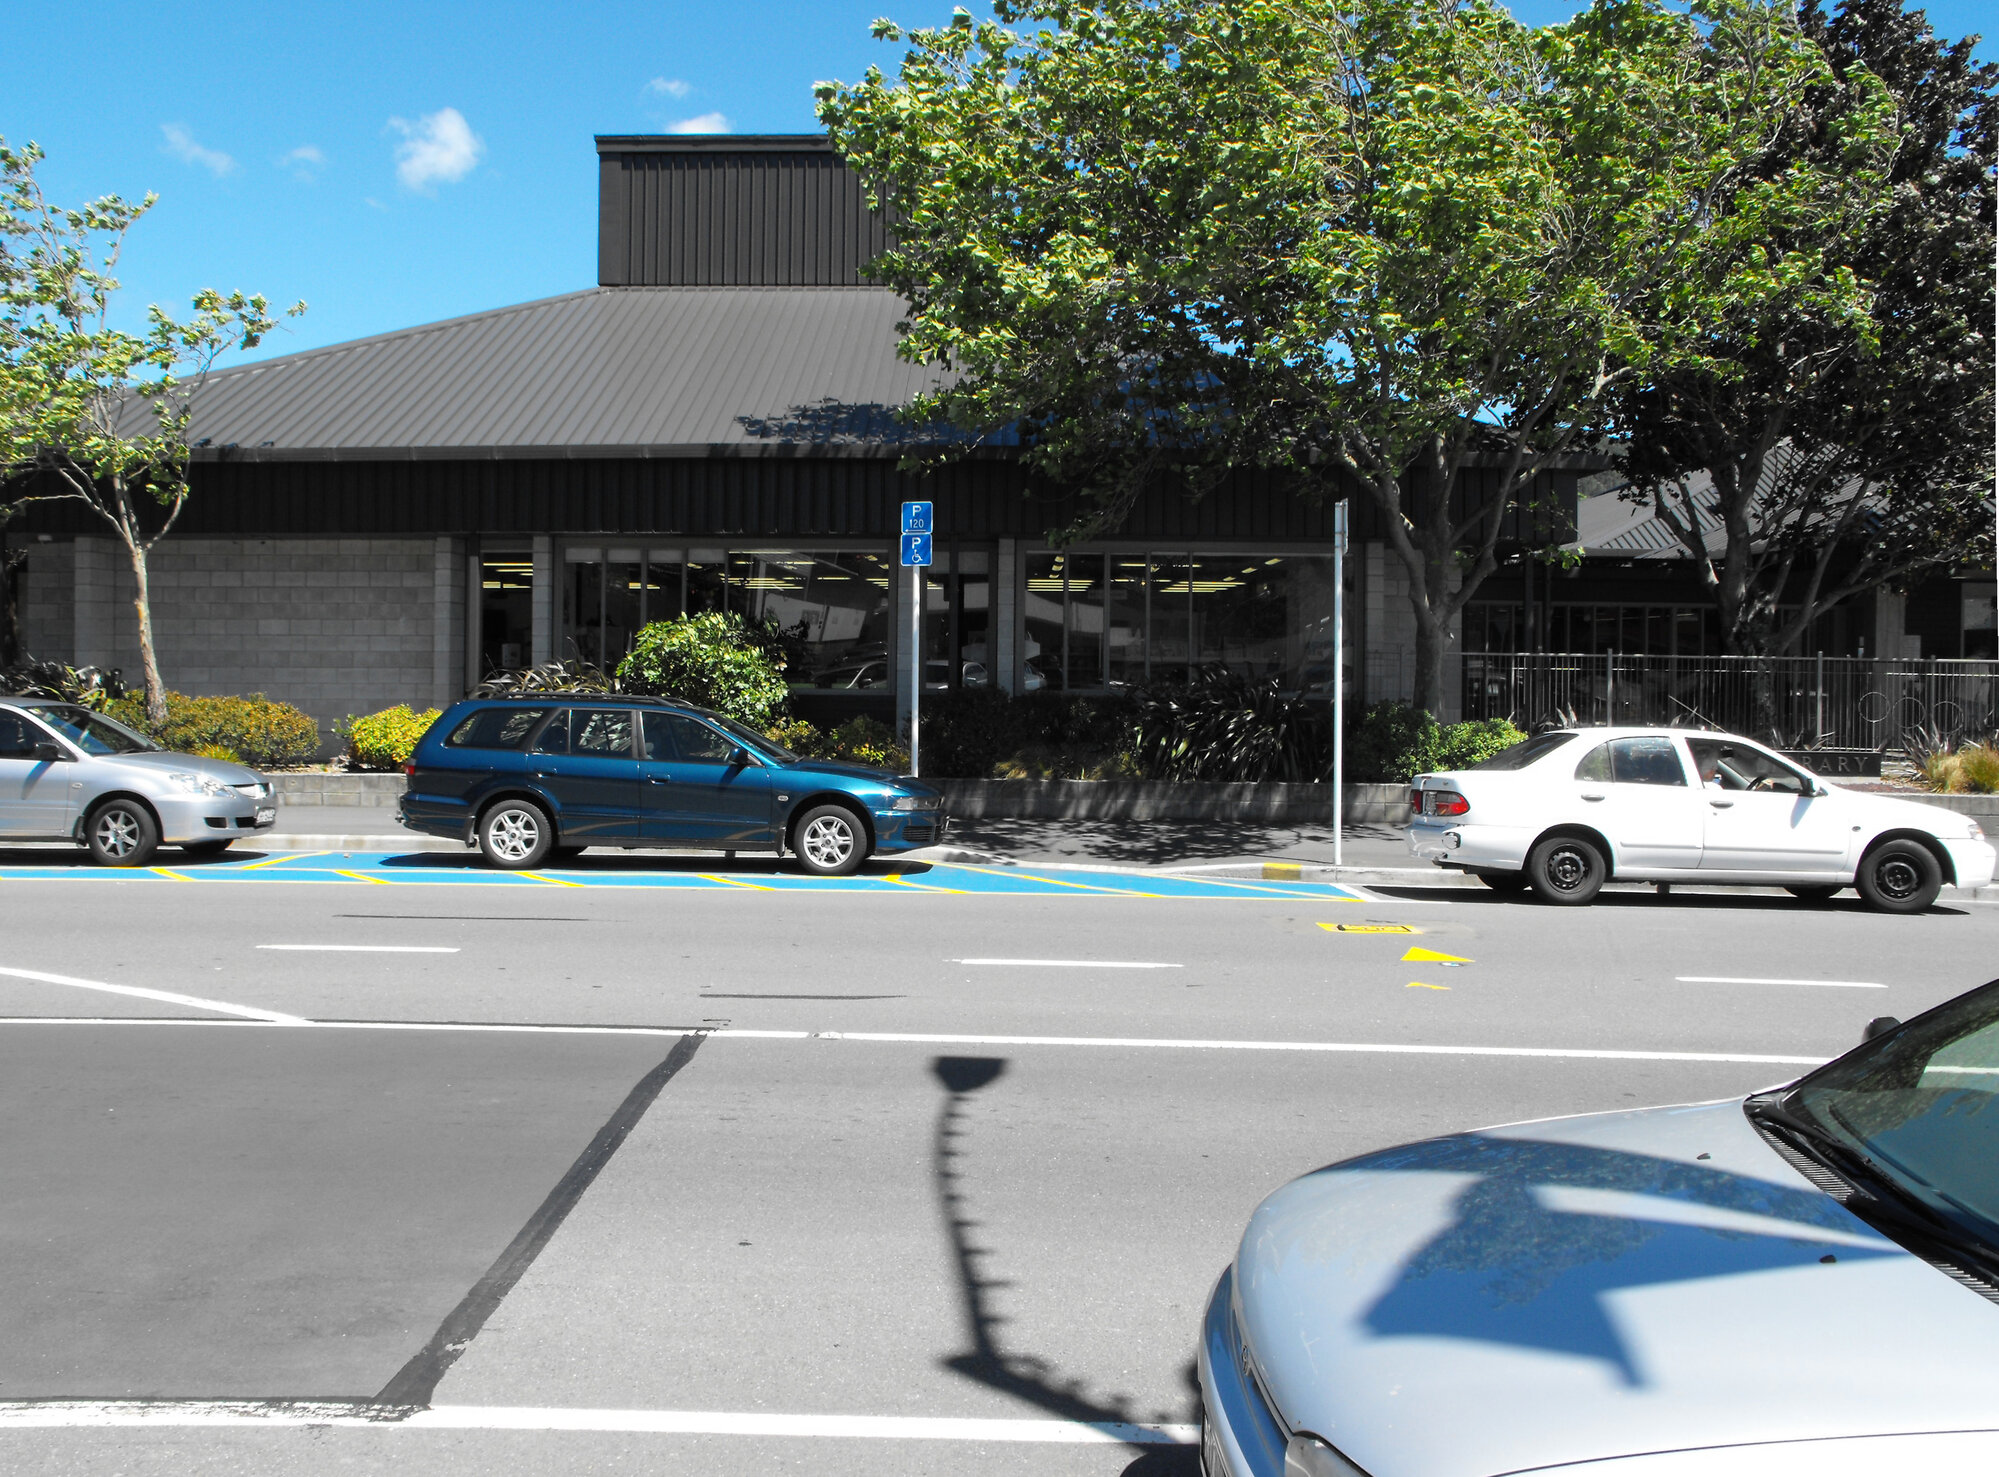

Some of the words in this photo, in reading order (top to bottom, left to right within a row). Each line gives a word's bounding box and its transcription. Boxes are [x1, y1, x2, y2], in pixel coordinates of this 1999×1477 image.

[912, 506, 922, 516] P
[910, 518, 924, 528] 120
[912, 537, 921, 549] P
[1801, 756, 1868, 772] RARY
